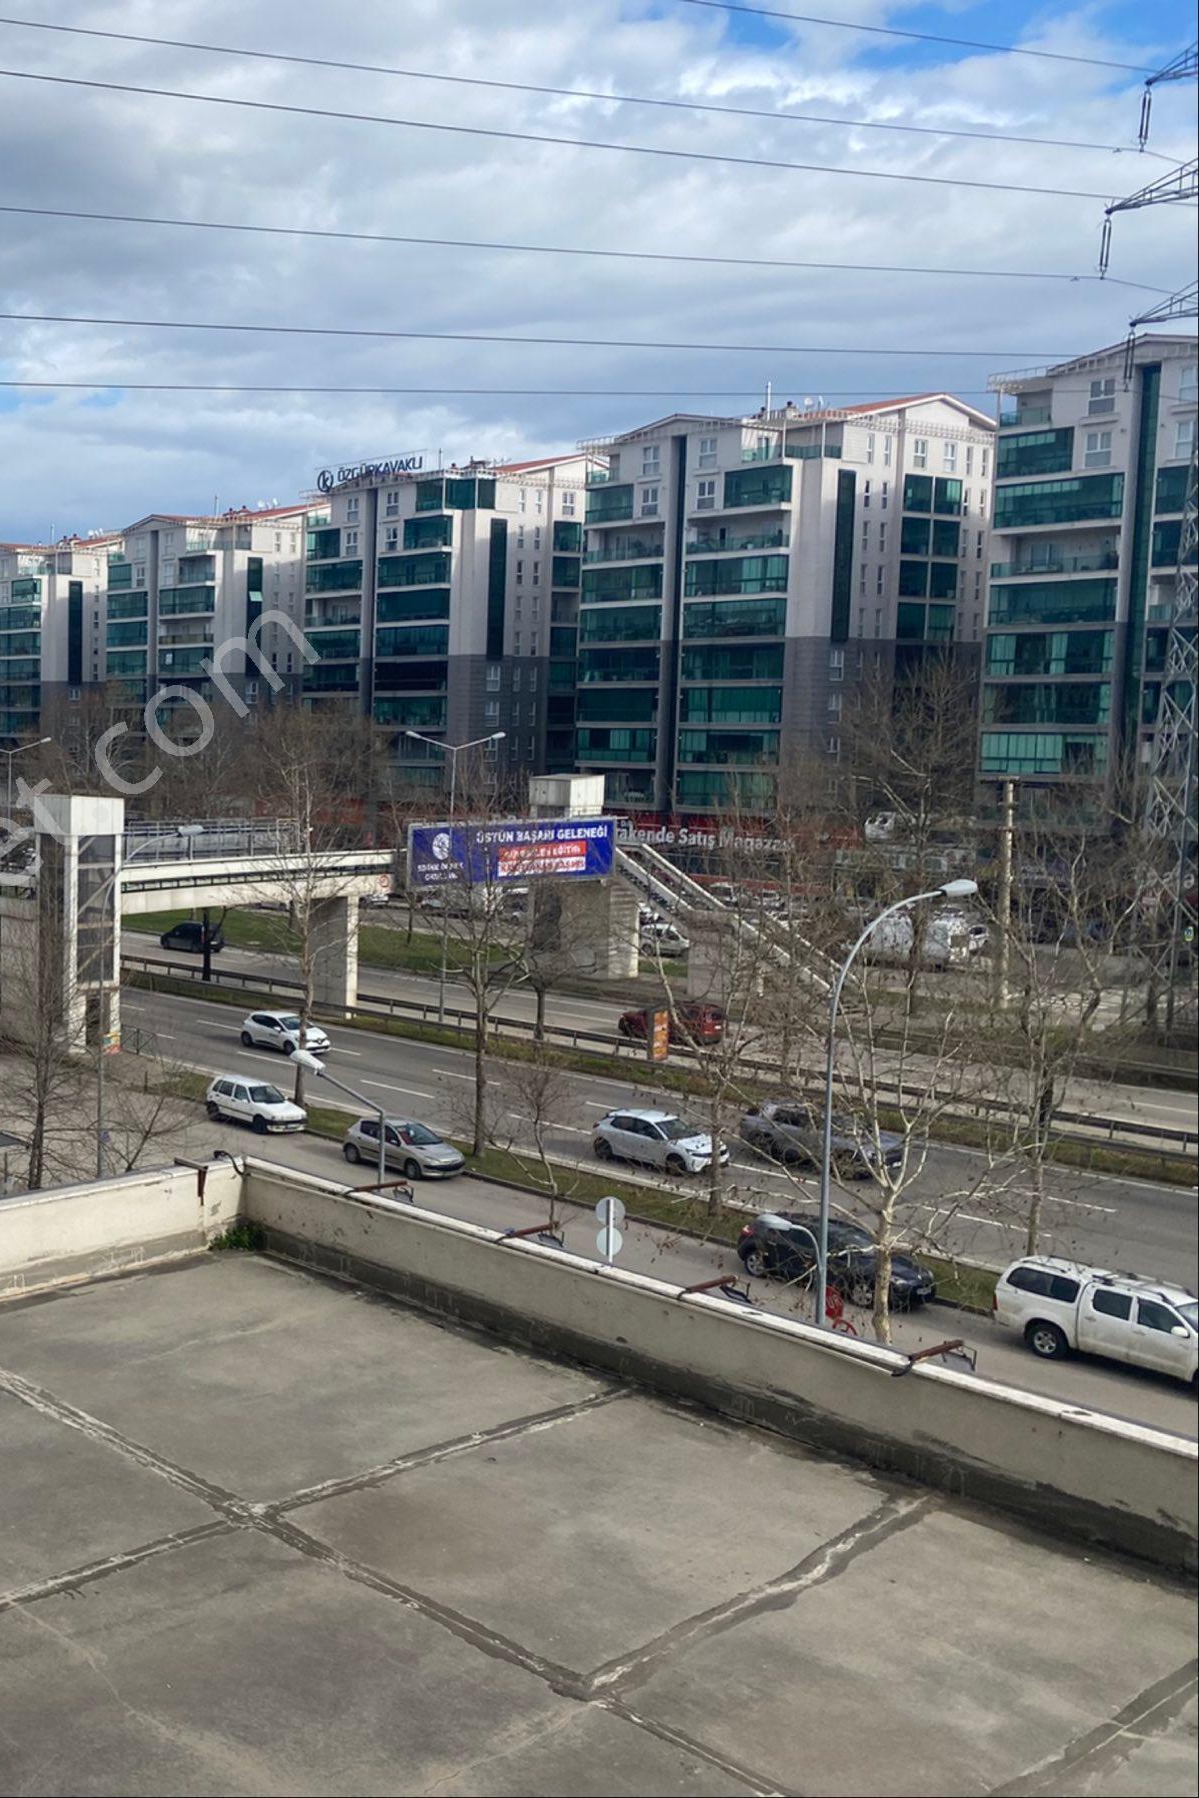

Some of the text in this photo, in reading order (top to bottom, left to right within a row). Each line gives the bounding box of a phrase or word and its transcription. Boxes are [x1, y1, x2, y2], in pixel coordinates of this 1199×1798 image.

[557, 825, 608, 840] GELENEĞİ
[616, 820, 675, 843] rakende
[678, 827, 716, 850] Satış
